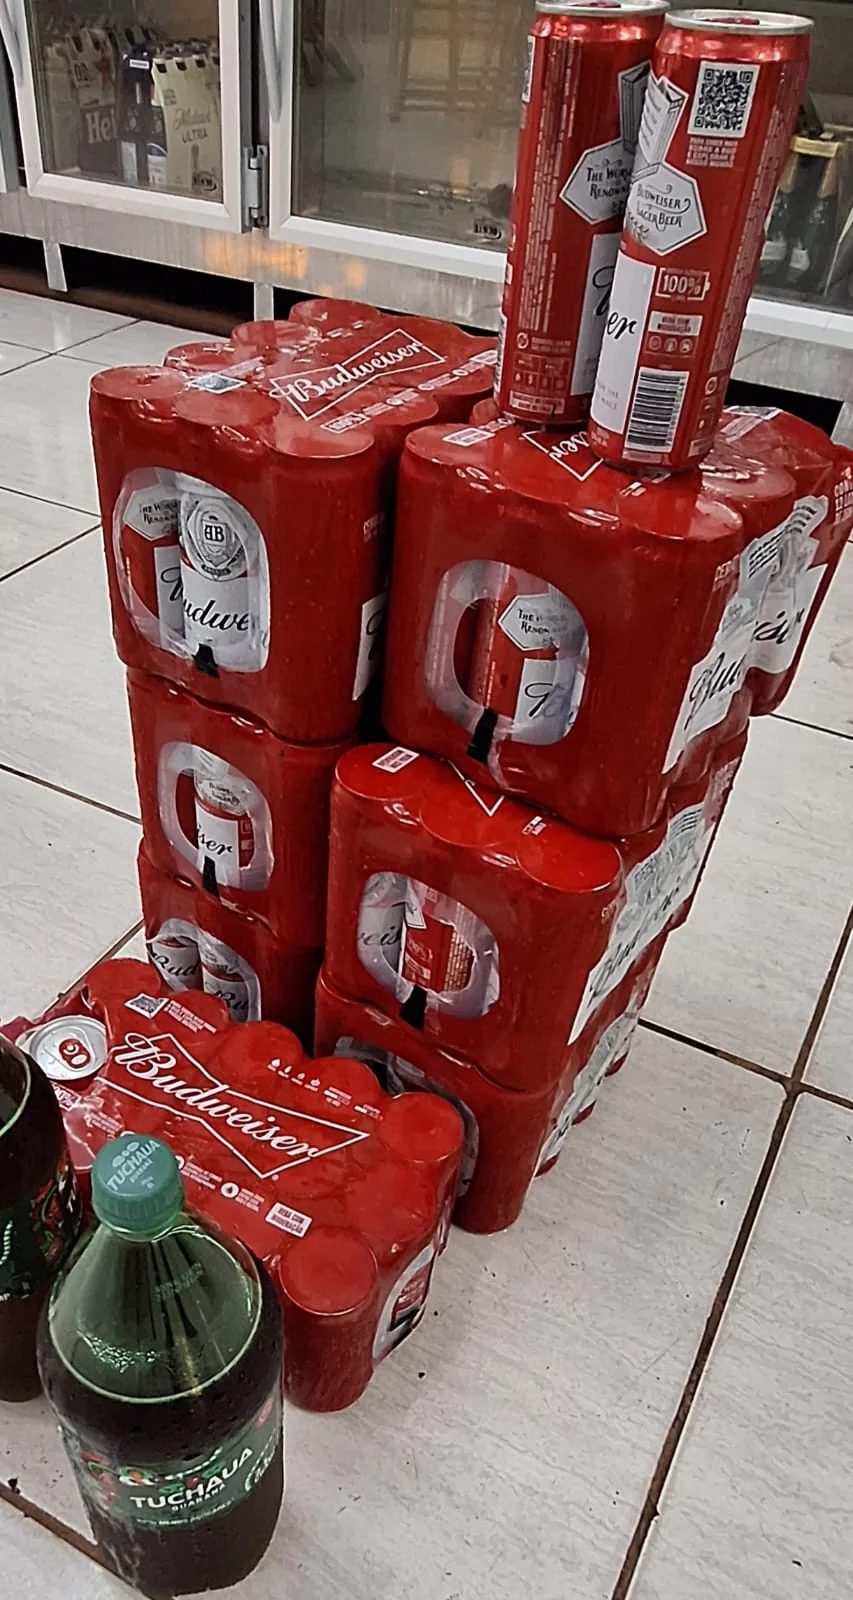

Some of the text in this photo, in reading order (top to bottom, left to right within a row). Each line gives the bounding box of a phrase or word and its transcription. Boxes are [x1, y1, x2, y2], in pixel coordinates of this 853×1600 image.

[586, 167, 603, 182] THE
[637, 184, 681, 209] BUDWEISER
[663, 274, 701, 295] 100%
[269, 340, 423, 405] Budweiser
[518, 609, 534, 622] THE
[114, 1032, 319, 1158] Budweiser
[107, 1139, 160, 1191] TUCHAUA
[130, 1448, 253, 1508] TUCHAUA
